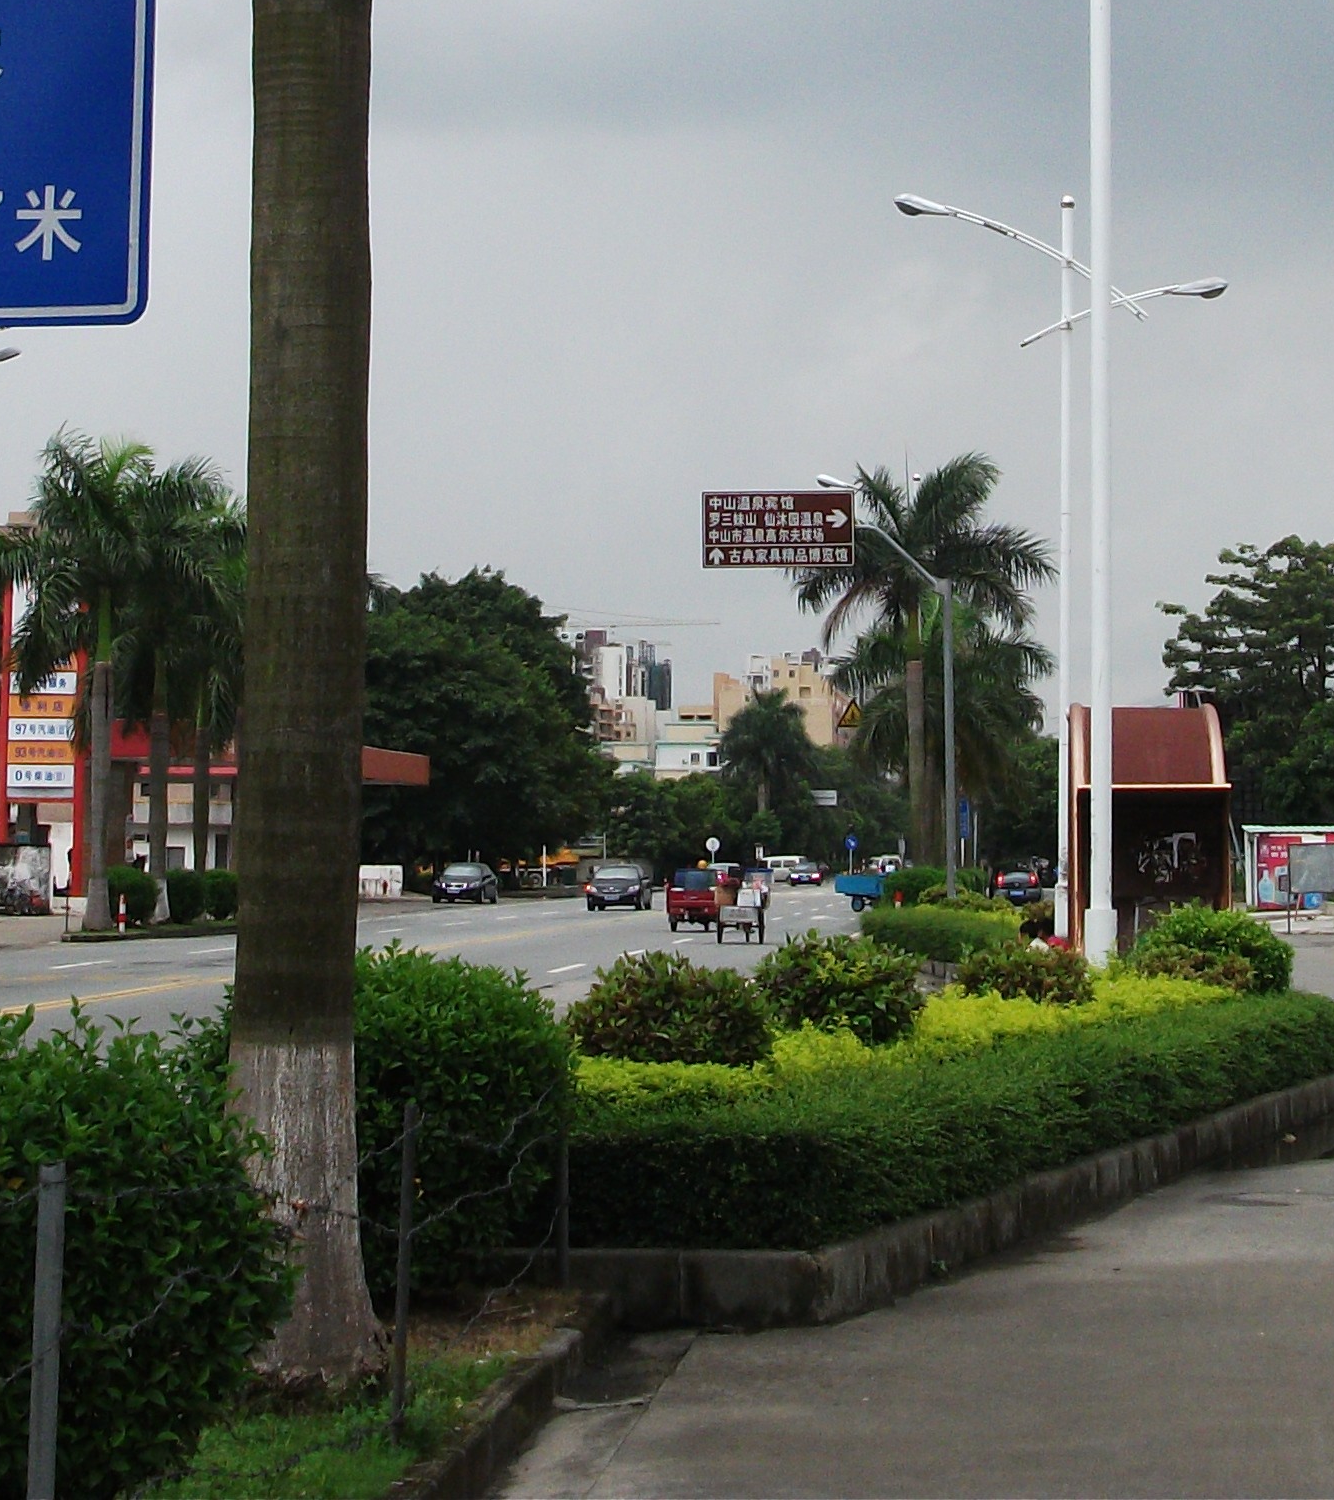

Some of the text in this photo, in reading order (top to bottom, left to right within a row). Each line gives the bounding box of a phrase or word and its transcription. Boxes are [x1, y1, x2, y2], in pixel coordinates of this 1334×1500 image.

[709, 496, 794, 510] 中山温泉宾馆
[709, 512, 757, 527] 罗三妹山
[708, 528, 824, 543] 中山市温泉高尔夫球场
[729, 547, 848, 563] 古典家具精品博览馆
